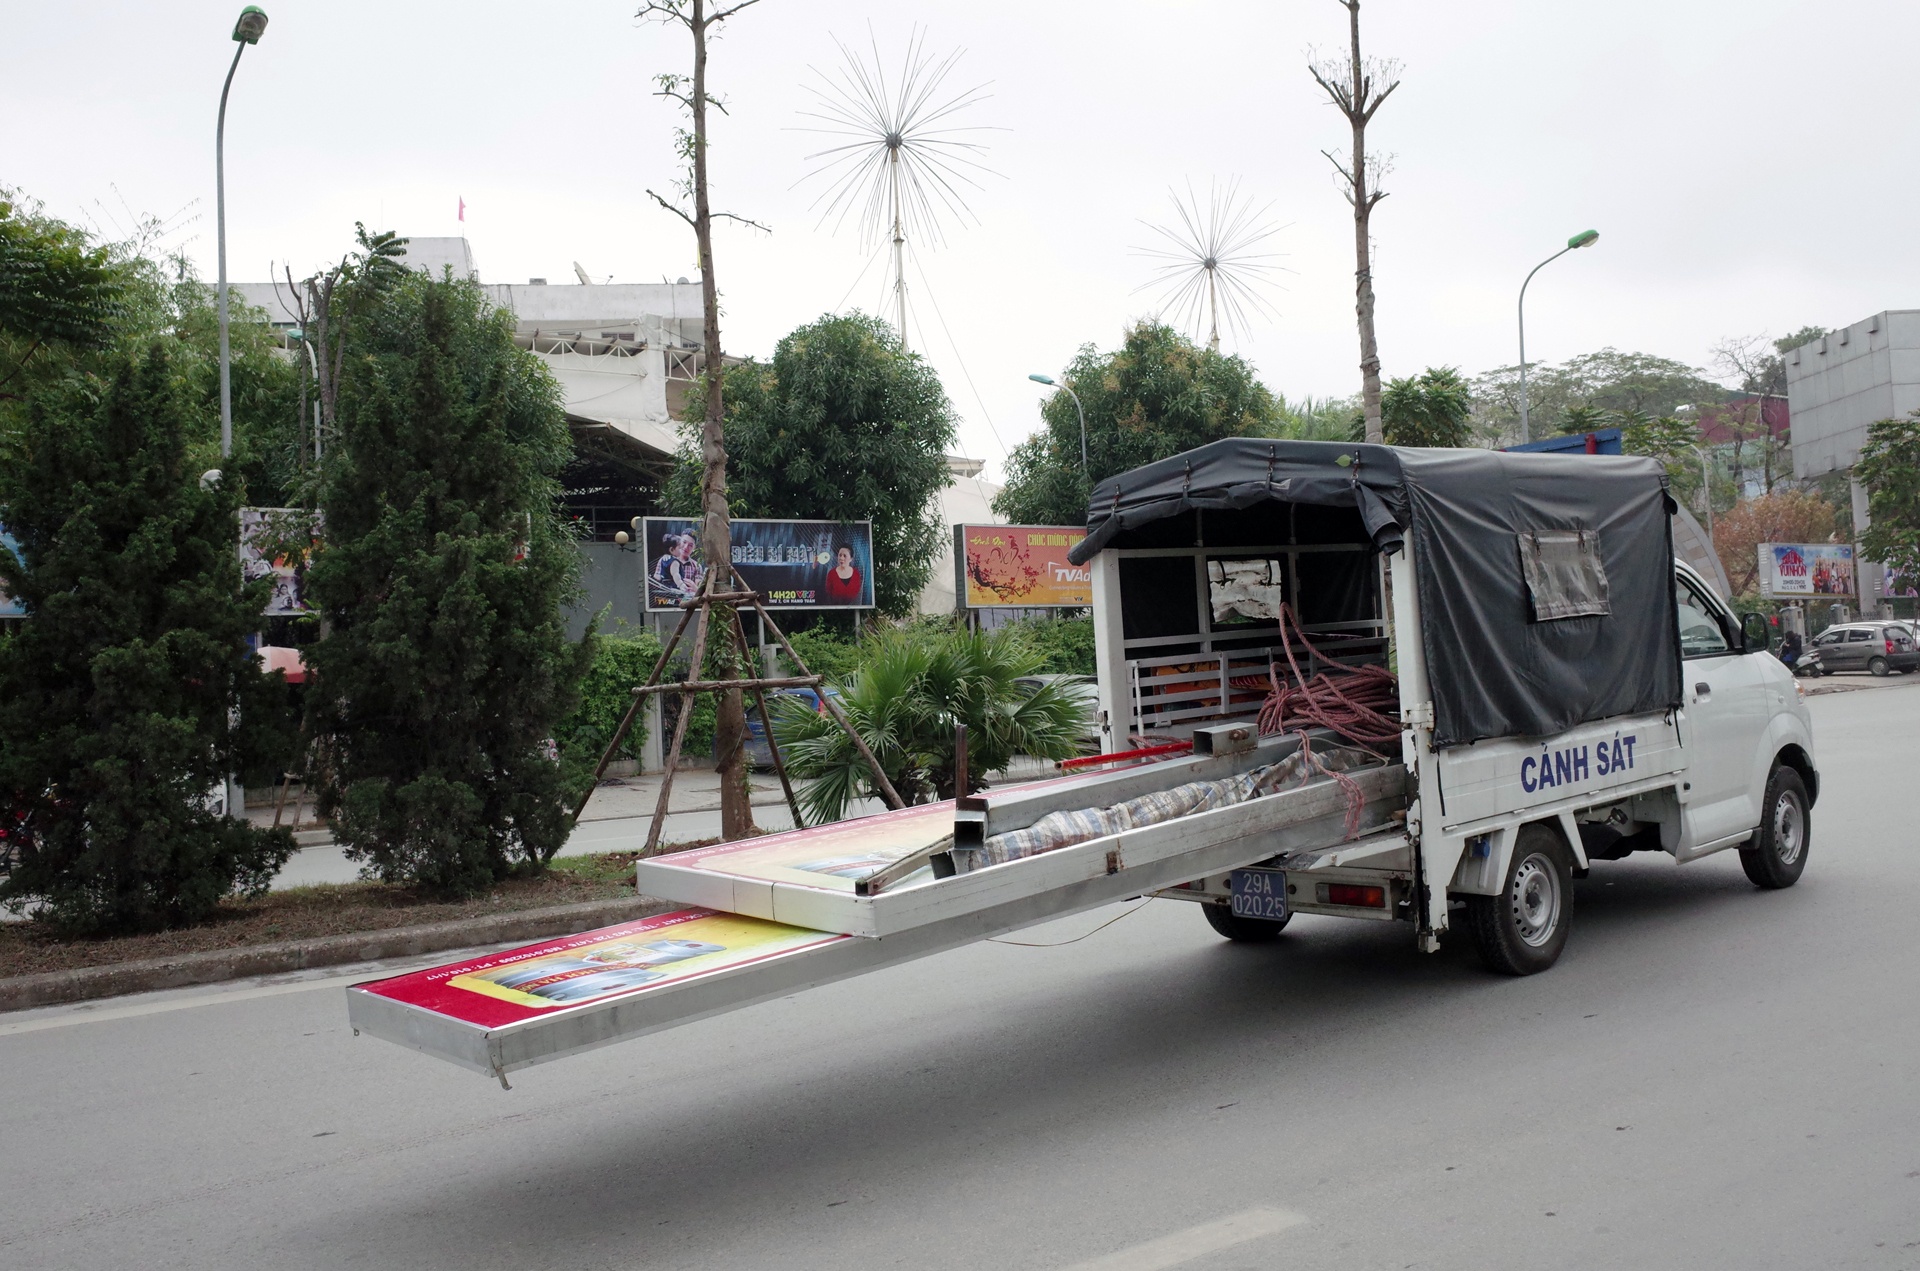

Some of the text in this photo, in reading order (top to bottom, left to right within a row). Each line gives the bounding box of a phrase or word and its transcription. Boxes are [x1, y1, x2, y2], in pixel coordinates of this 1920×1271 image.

[731, 541, 764, 563] ĐIỀU
[767, 544, 783, 563] BÍ
[768, 591, 796, 599] 14H20
[1521, 730, 1637, 793] CẢNH SÁT
[1243, 873, 1272, 895] 29A
[1233, 894, 1285, 918] 020.25
